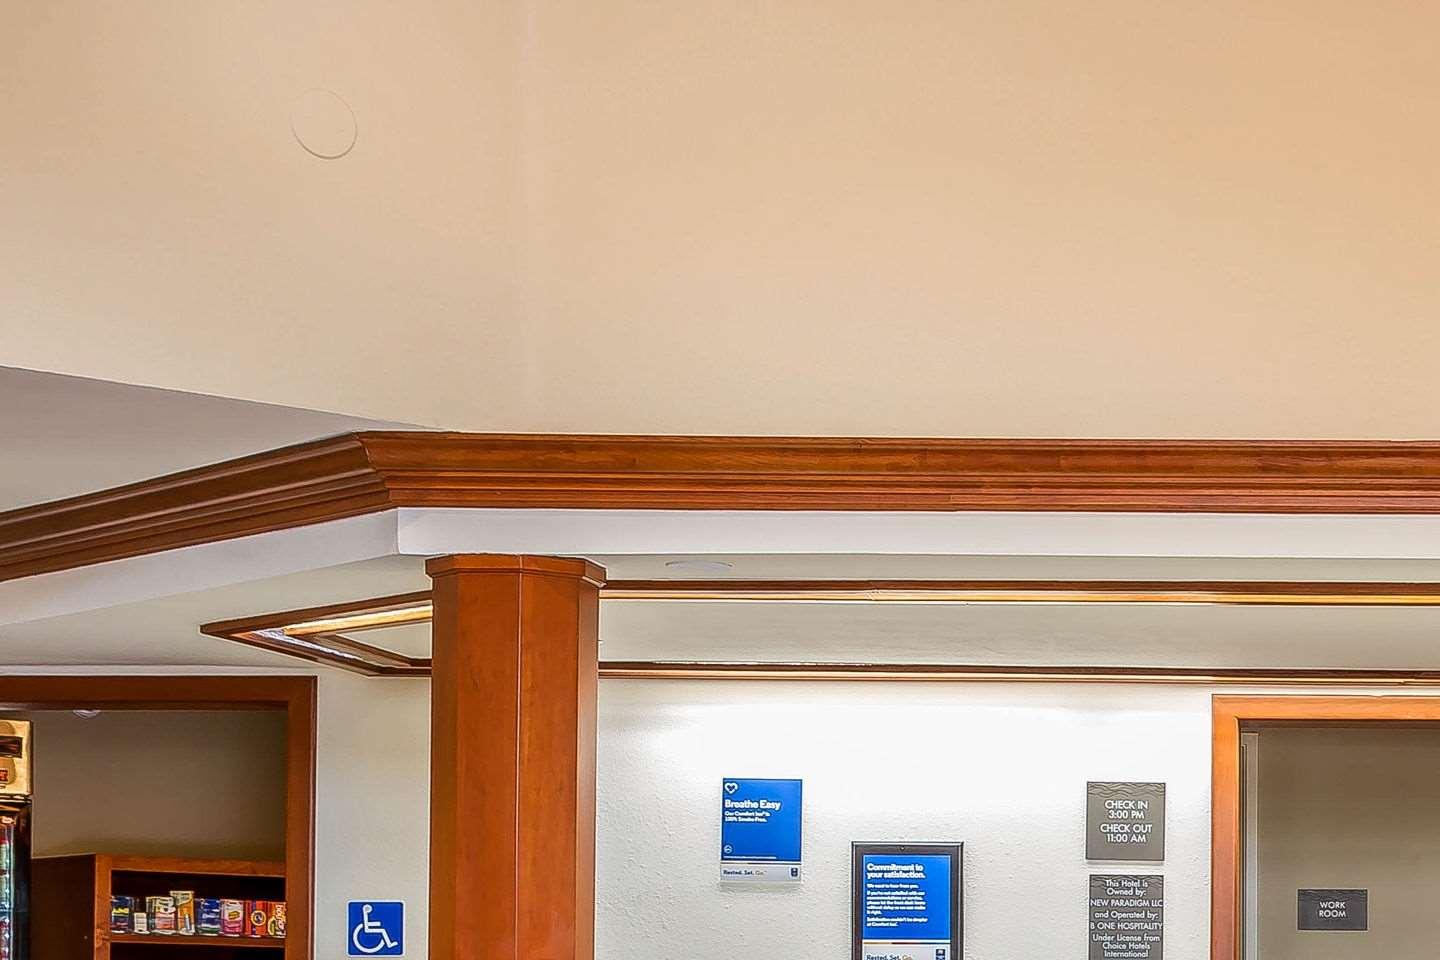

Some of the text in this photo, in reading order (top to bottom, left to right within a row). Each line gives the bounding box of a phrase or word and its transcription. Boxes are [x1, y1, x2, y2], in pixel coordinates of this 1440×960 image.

[725, 799, 781, 811] Breathe Easy
[1104, 800, 1148, 809] CHECK IN
[1108, 810, 1145, 819] 3:00 PM
[1100, 823, 1153, 833] CHECK OUT
[1106, 833, 1147, 843] 11:00 AM
[867, 872, 883, 880] your
[1121, 880, 1140, 888] Hotel
[1106, 887, 1133, 896] Owned
[1090, 899, 1109, 907] NEW
[1110, 899, 1150, 907] PARADIGM
[1319, 901, 1346, 909] WORK
[1094, 910, 1109, 919] and
[1110, 910, 1145, 920] Operated
[1319, 909, 1347, 918] ROOM
[1096, 922, 1116, 930] ONE
[1117, 921, 1163, 930] HOSPITALITY
[1092, 933, 1160, 942] Under License from
[1102, 941, 1151, 950] Choice Hotels
[1104, 950, 1149, 958] International
